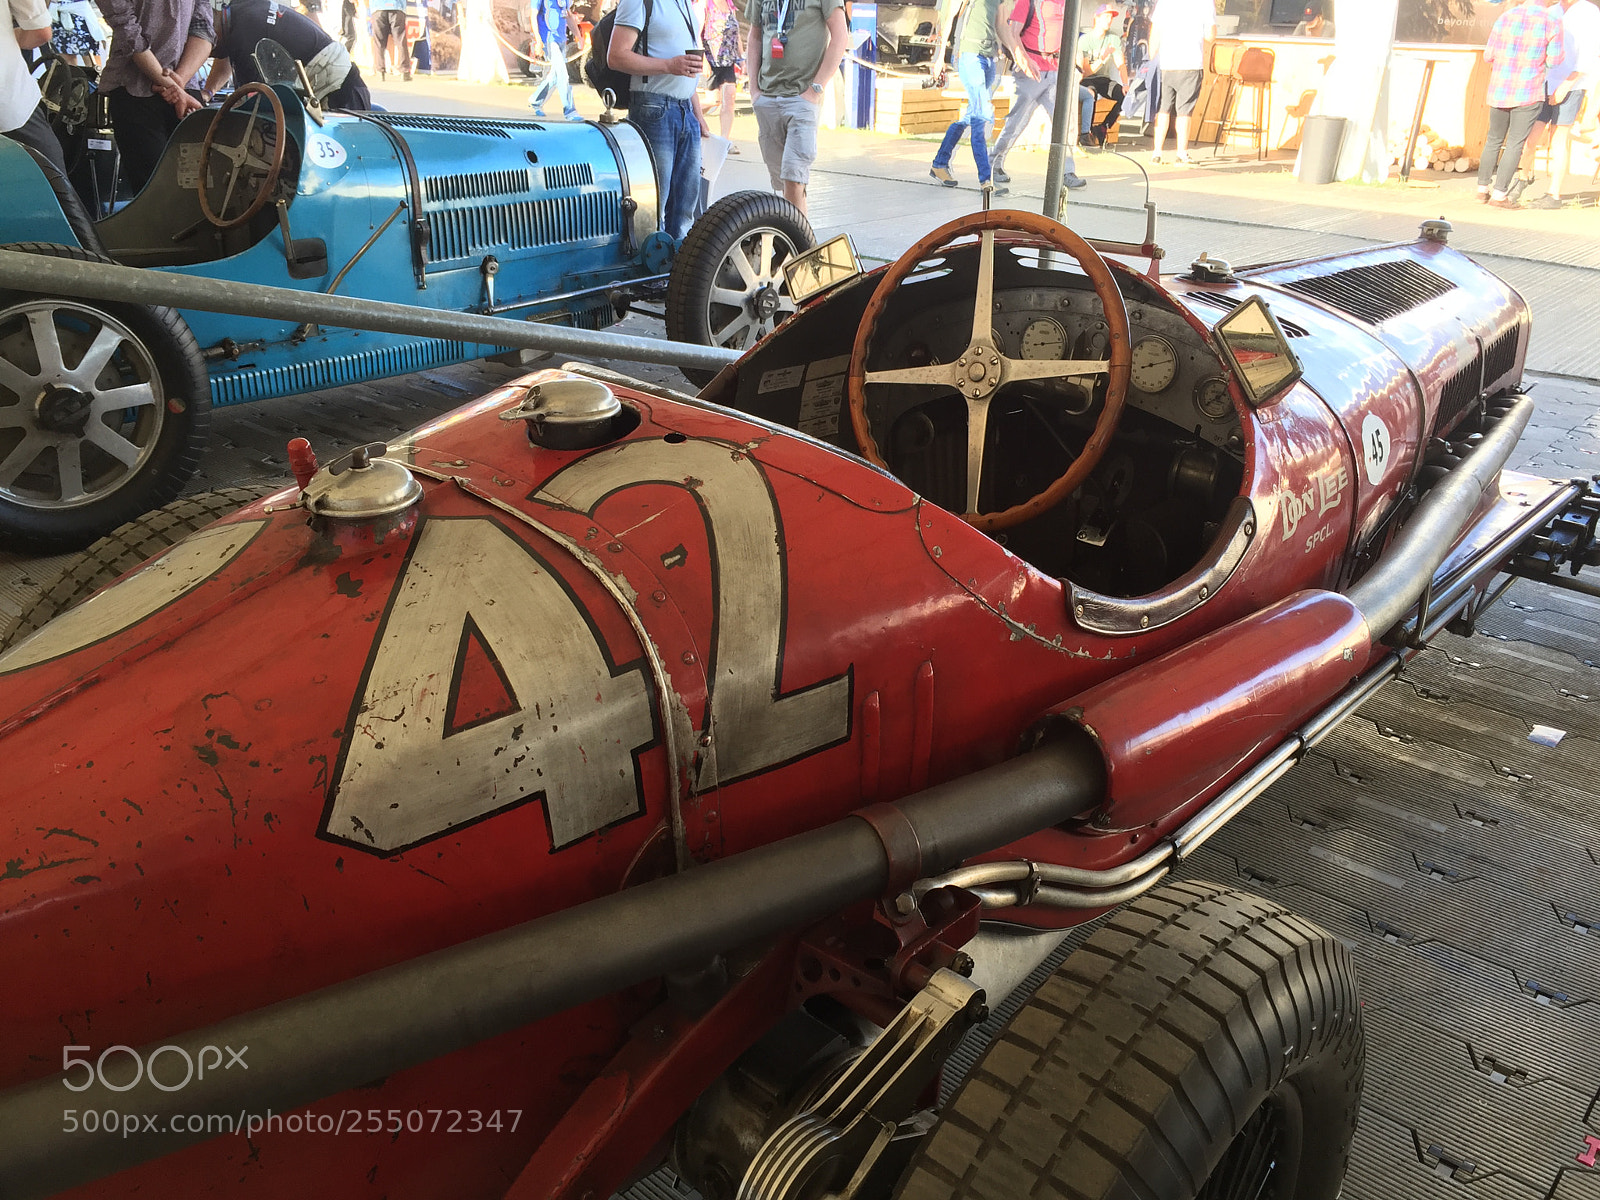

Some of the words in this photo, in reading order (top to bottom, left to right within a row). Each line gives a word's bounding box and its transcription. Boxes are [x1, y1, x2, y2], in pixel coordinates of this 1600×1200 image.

[1437, 16, 1476, 27] beyond
[317, 141, 335, 158] 35
[1371, 428, 1384, 467] 45
[1304, 523, 1334, 554] SPCL.
[316, 437, 853, 857] 42
